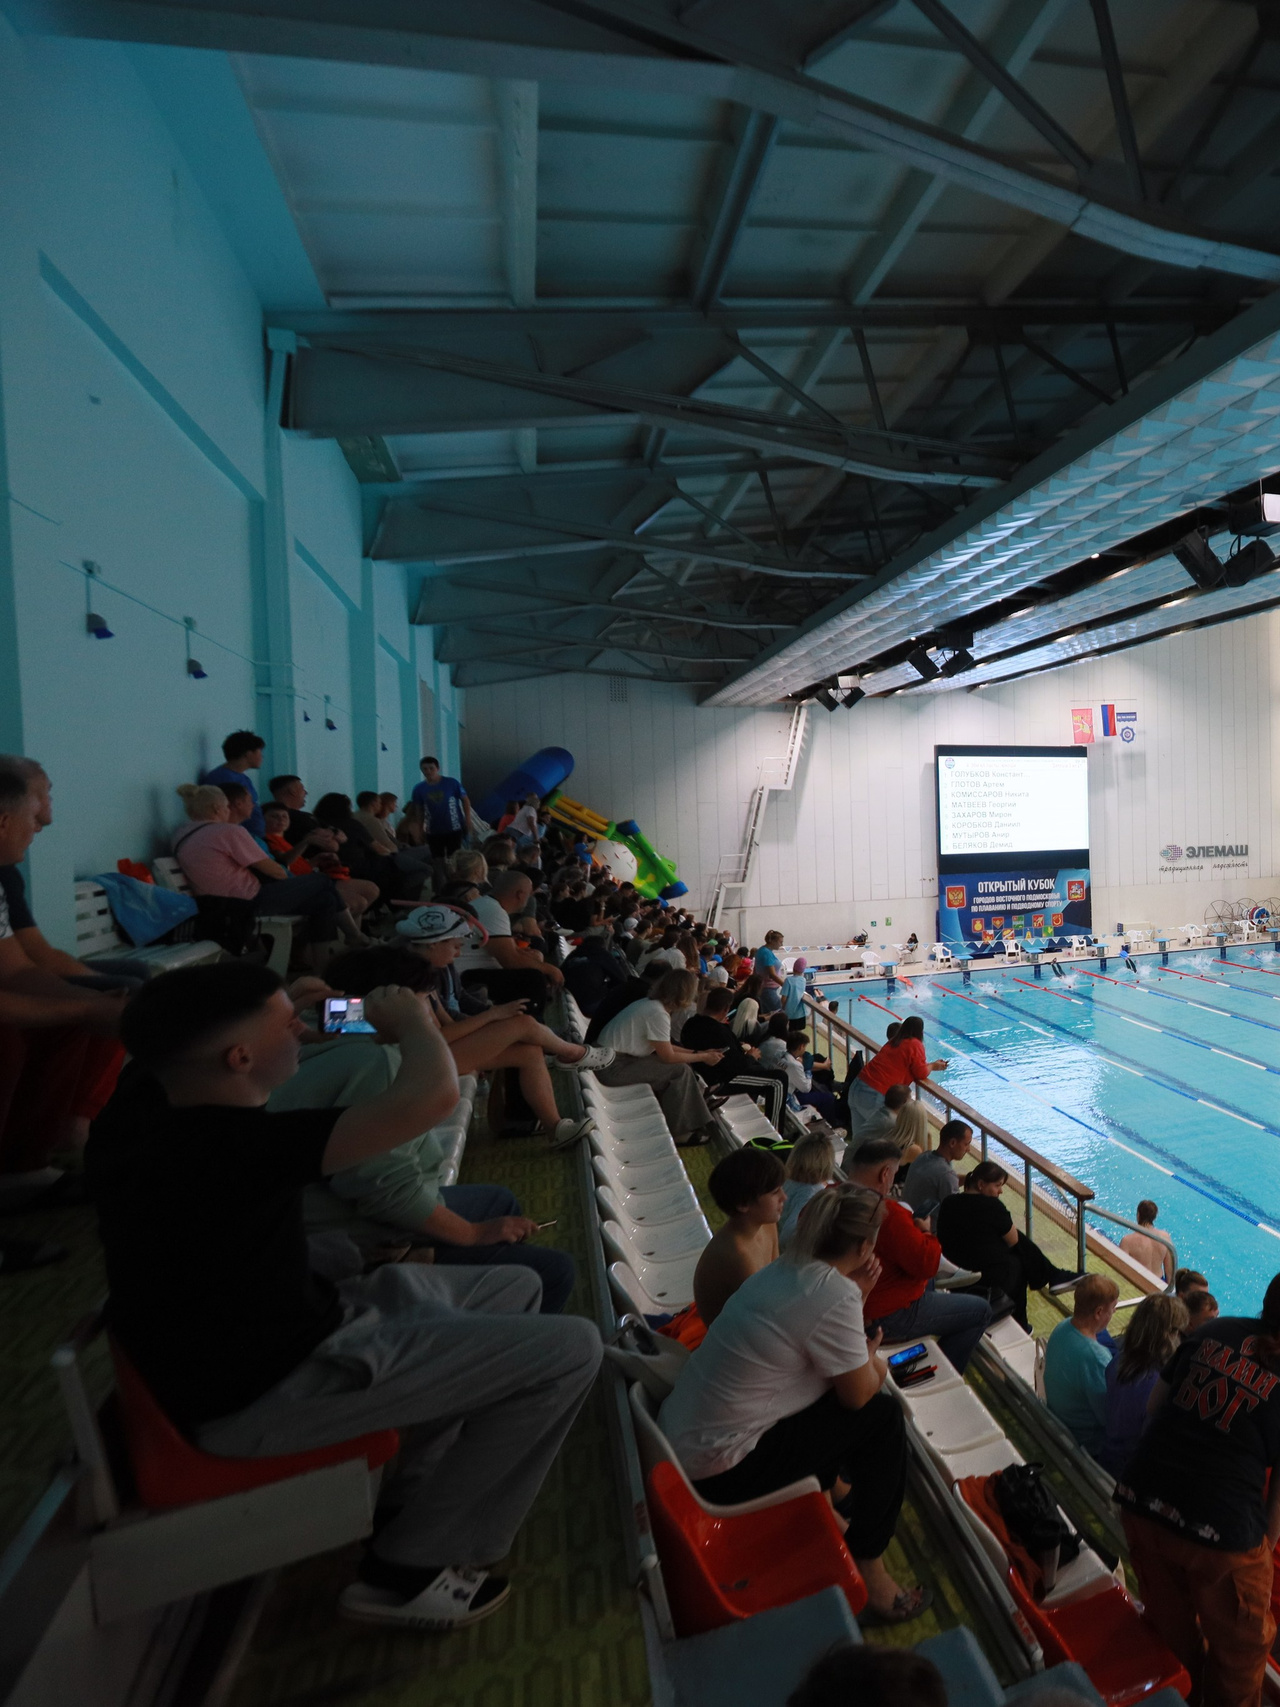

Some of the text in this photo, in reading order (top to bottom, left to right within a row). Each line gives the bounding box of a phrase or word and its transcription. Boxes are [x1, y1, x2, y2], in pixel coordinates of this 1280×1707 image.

[1186, 844, 1249, 859] ЭЛЕМАШ
[978, 878, 1055, 893] ОТКРЫТЫЙ КУБОК
[973, 892, 1060, 904] ГОРОДОВ ВОСТОЧНОГО ПОДМОСКОВЬЯ
[979, 904, 1006, 912] ПЛАВАНИЮ
[1011, 901, 1045, 910] ПОДВОДНОМУ
[1045, 900, 1063, 908] СПОРТУ
[1173, 1364, 1261, 1433] БОГ
